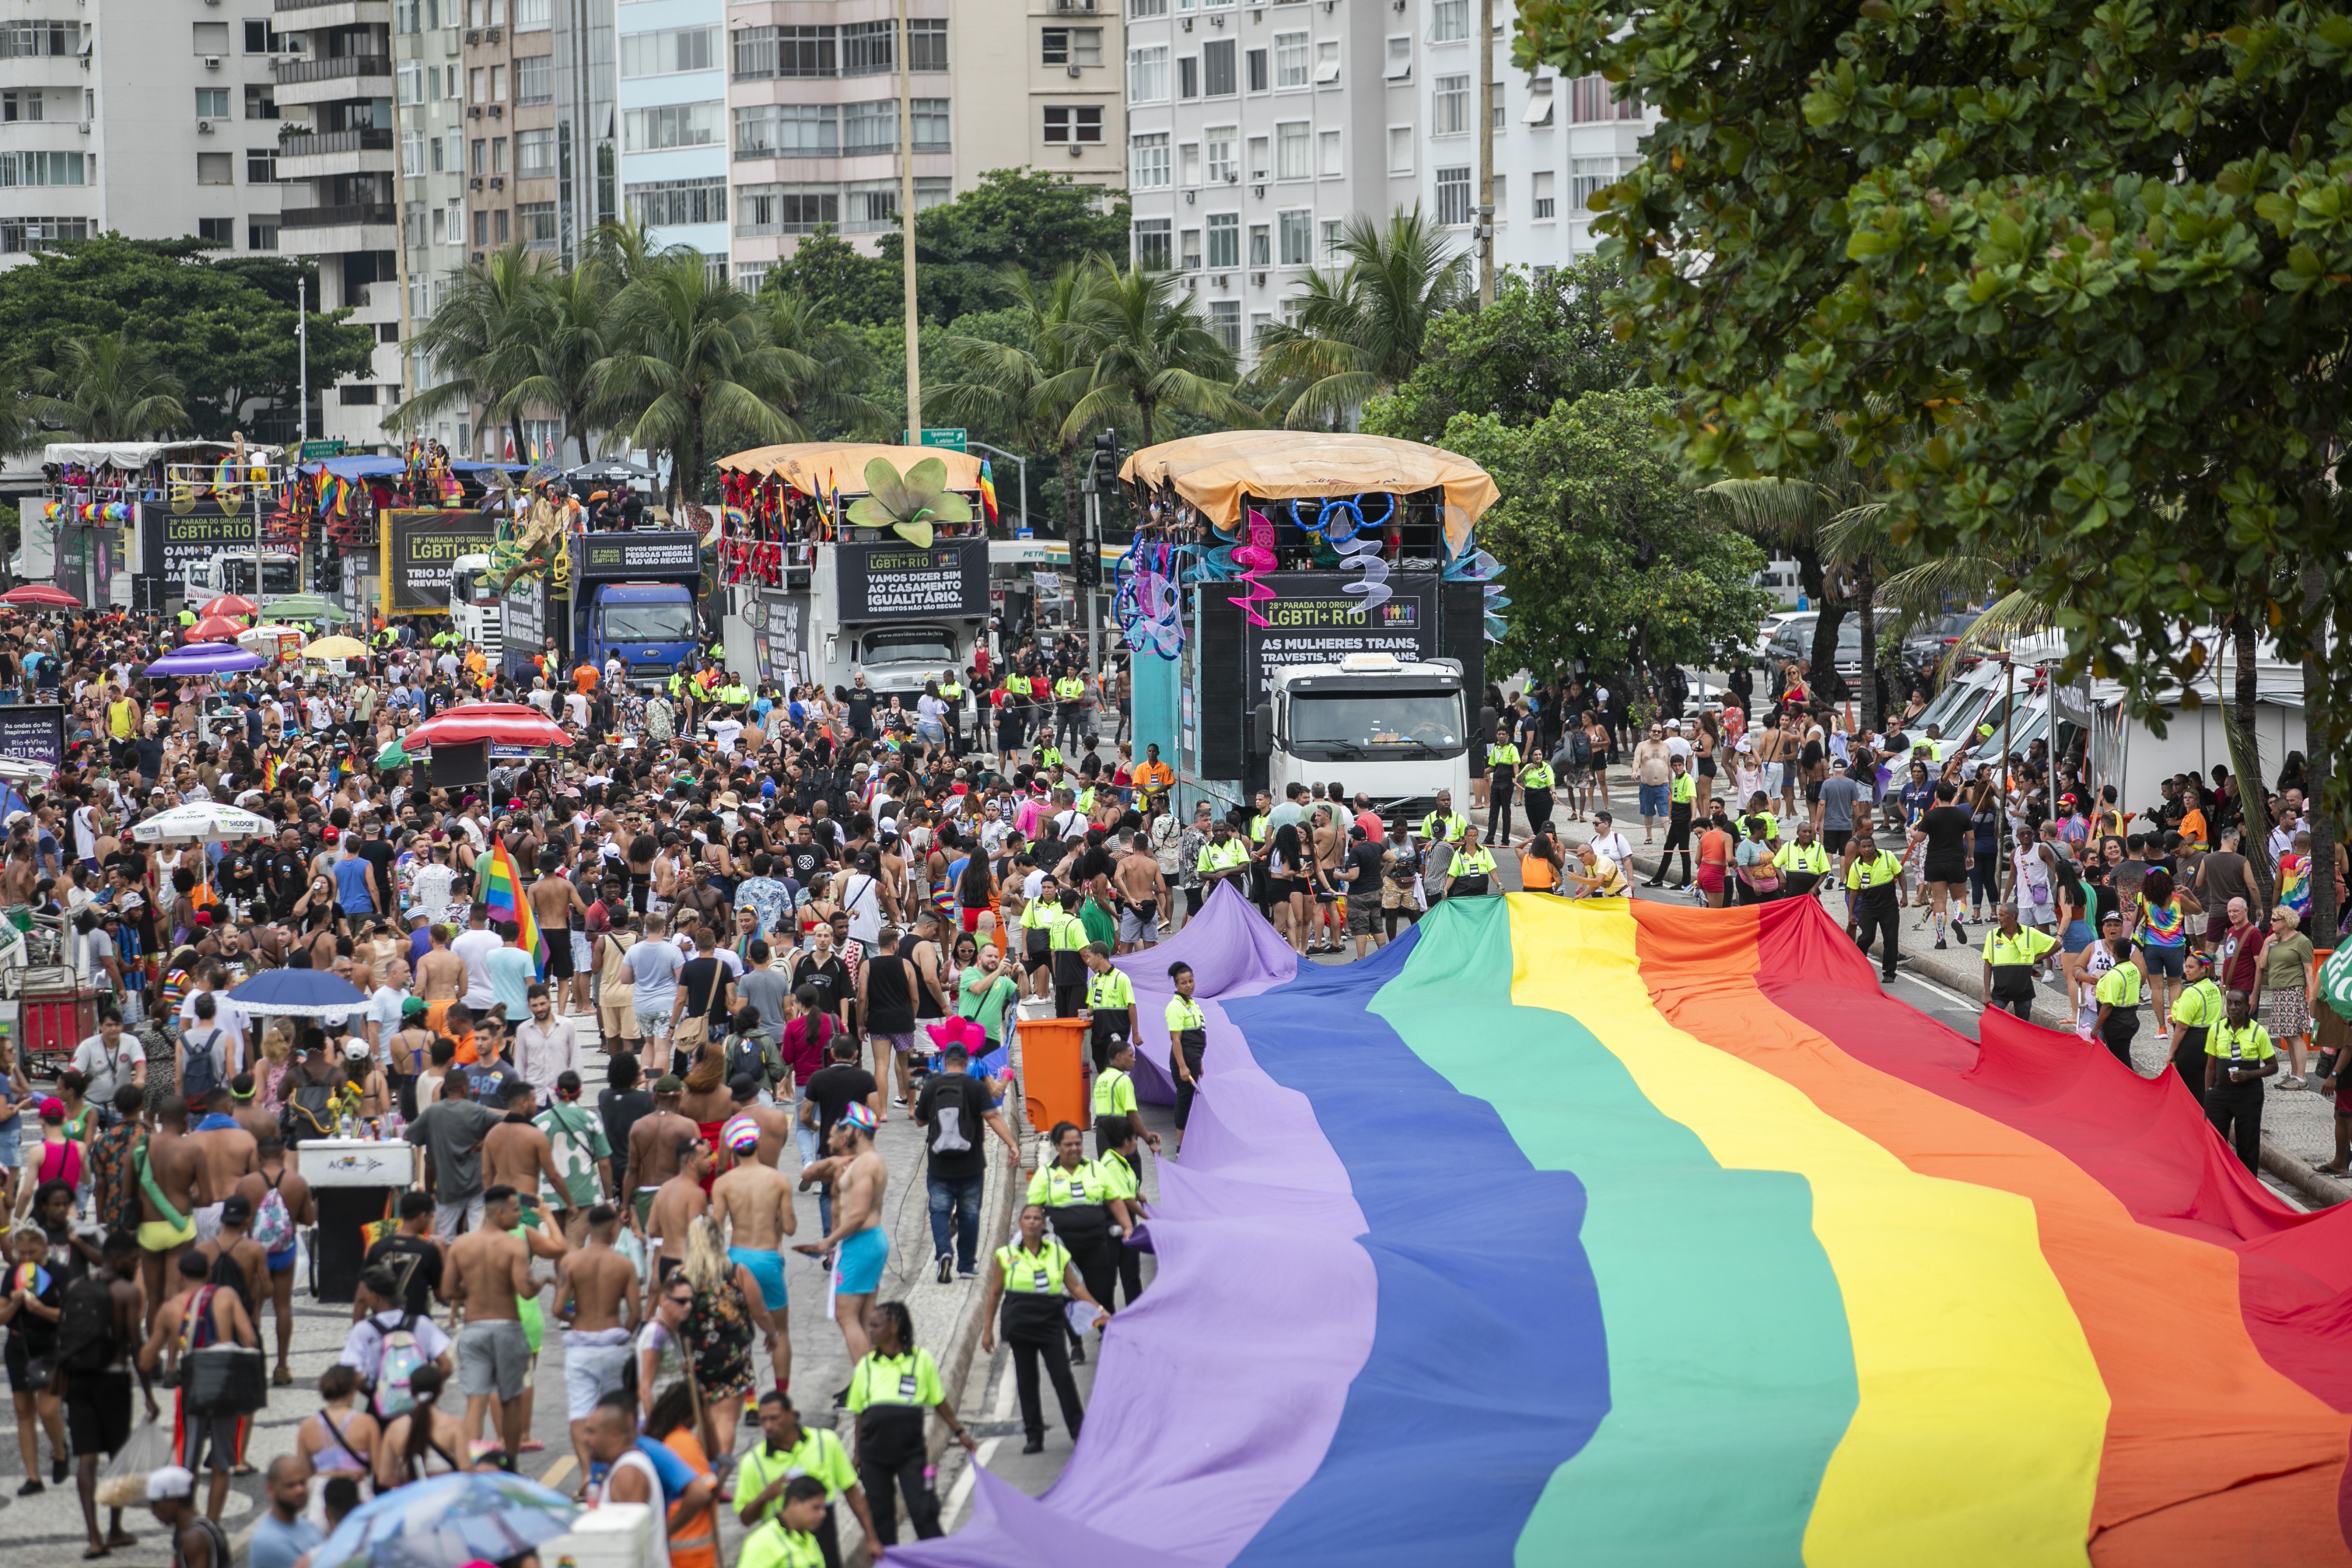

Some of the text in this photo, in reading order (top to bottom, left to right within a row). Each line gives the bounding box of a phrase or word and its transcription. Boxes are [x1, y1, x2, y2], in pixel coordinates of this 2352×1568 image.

[169, 524, 252, 539] LGBTI+ RIO
[164, 546, 174, 556] O
[413, 544, 467, 559] LGBTI+
[344, 554, 355, 576] NÓS
[870, 557, 929, 569] LGBTI+ RIO
[407, 568, 453, 578] TRIO DA
[867, 571, 961, 583] VAMOS DIZER SIM
[344, 576, 355, 597] NÃO
[868, 581, 962, 593] AO CASAMENTO
[868, 590, 962, 605] IGUALITÁRIO.
[787, 602, 798, 629] NÓS
[1269, 609, 1366, 625] LGBTI+ RIO
[786, 628, 797, 654] NÃO
[1261, 638, 1420, 651] AS MULHERES TRANS,
[1261, 653, 1326, 662] TRAVESTIS,
[4, 747, 54, 758] DEU BOM
[2127, 968, 2137, 979] sigma
[2205, 989, 2218, 997] sigma
[470, 1075, 502, 1094] 987
